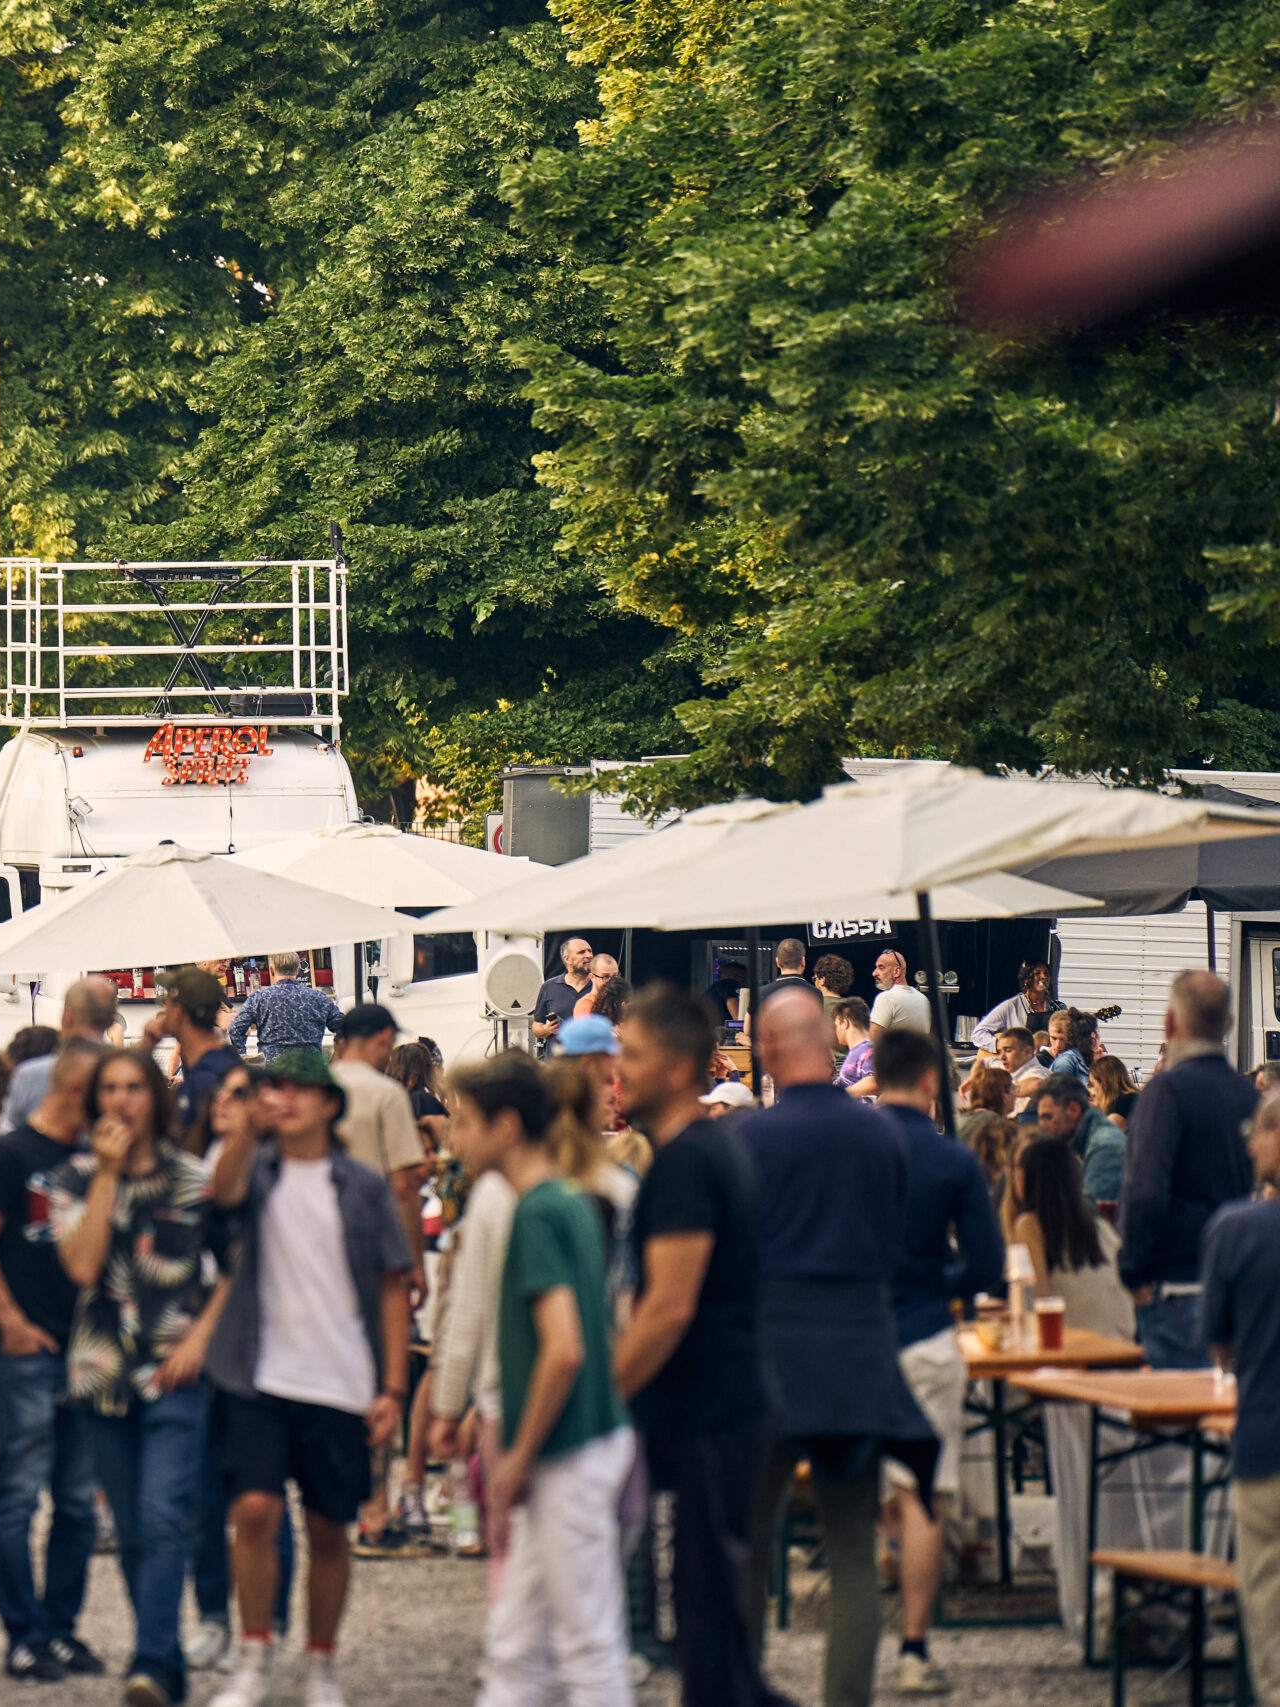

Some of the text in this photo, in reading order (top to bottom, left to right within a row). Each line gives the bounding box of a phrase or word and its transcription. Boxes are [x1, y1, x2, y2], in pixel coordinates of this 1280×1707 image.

[143, 722, 274, 763] APEROL
[161, 758, 250, 785] SPRITZ
[811, 918, 892, 939] CASSA
